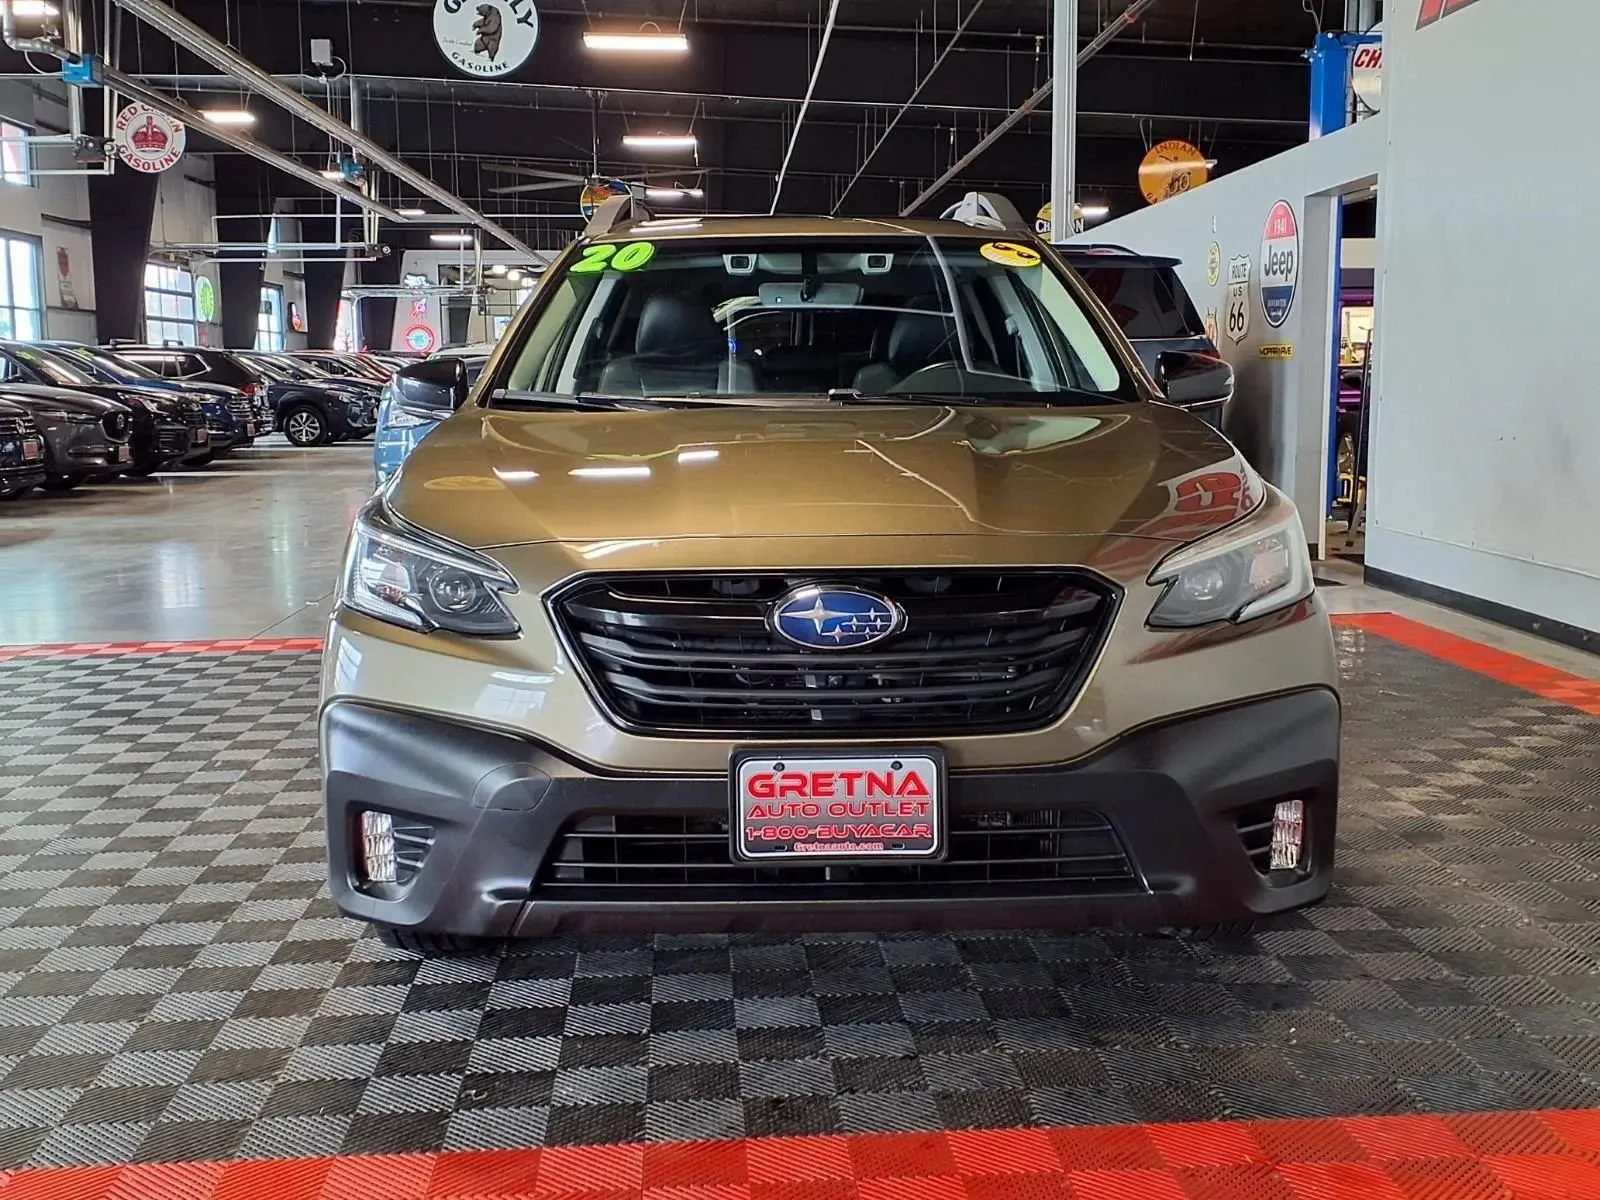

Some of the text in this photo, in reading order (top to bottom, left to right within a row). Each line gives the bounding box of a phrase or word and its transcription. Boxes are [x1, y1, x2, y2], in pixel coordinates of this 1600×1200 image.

[451, 51, 510, 73] GASOLINE
[116, 105, 138, 131] RED
[119, 144, 181, 171] GASOLINE
[1154, 142, 1197, 157] INDIAN
[570, 241, 655, 272] 20
[1264, 244, 1294, 282] Jeep
[1231, 263, 1248, 279] ROUTE
[1233, 286, 1243, 298] US
[1229, 301, 1245, 332] 66
[747, 771, 930, 799] GRETNA
[746, 801, 930, 820] AUTO OUTLET
[746, 823, 932, 841] 1-800-BUYACAR
